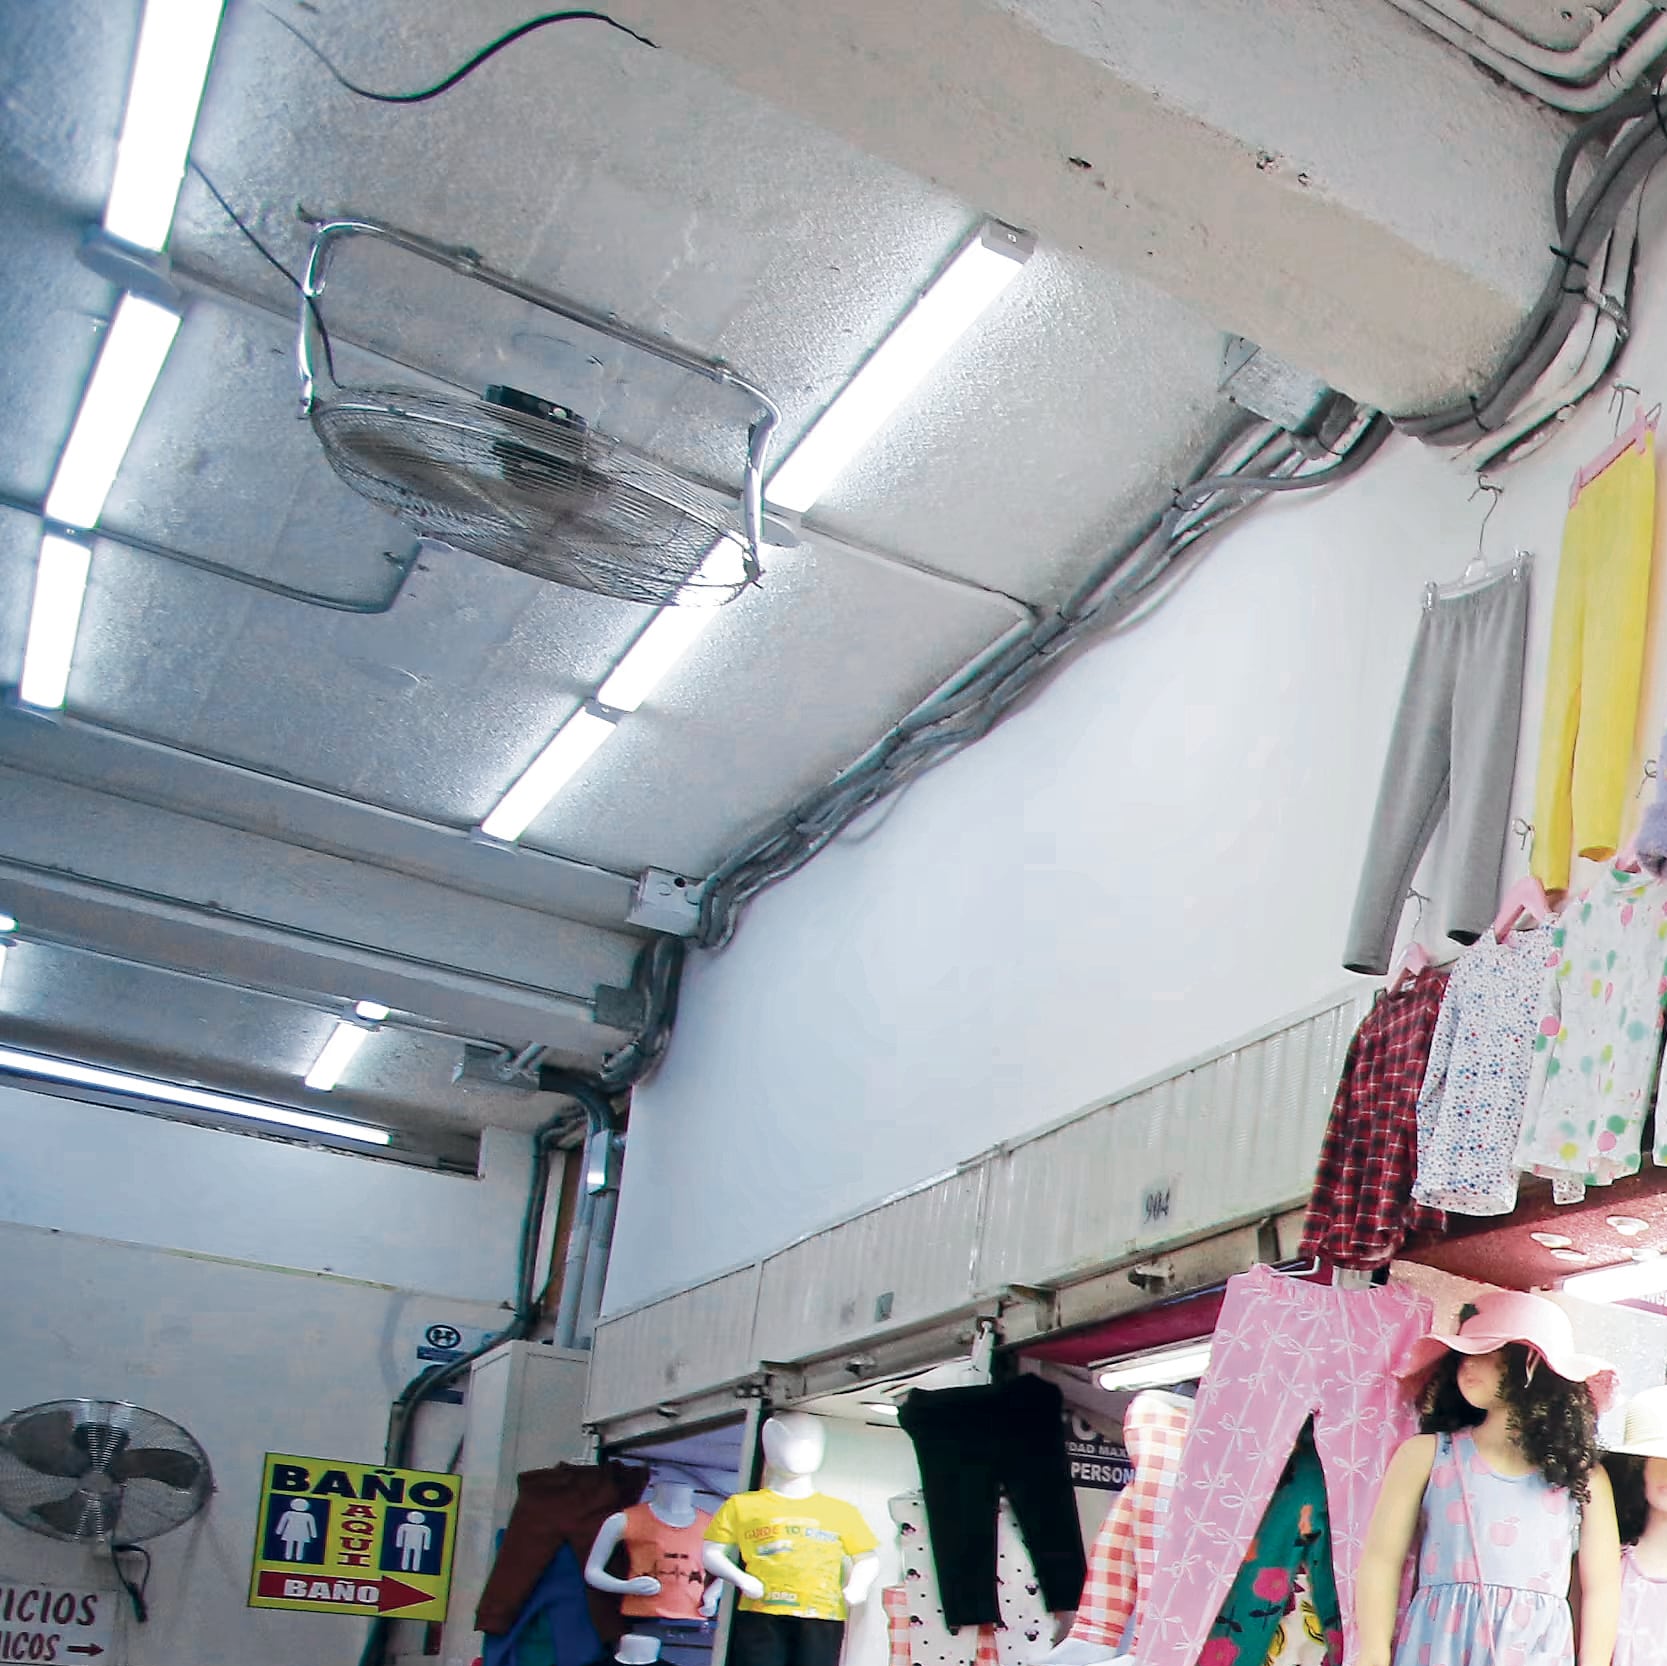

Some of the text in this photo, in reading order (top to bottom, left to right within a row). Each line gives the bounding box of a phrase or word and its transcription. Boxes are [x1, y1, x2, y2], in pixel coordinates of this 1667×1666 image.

[271, 1464, 454, 1508] BAÑO
[337, 1504, 377, 1567] AQUI
[0, 1588, 98, 1626] ICIOS
[283, 1578, 380, 1604] BAÑO
[0, 1630, 60, 1661] ICOS
